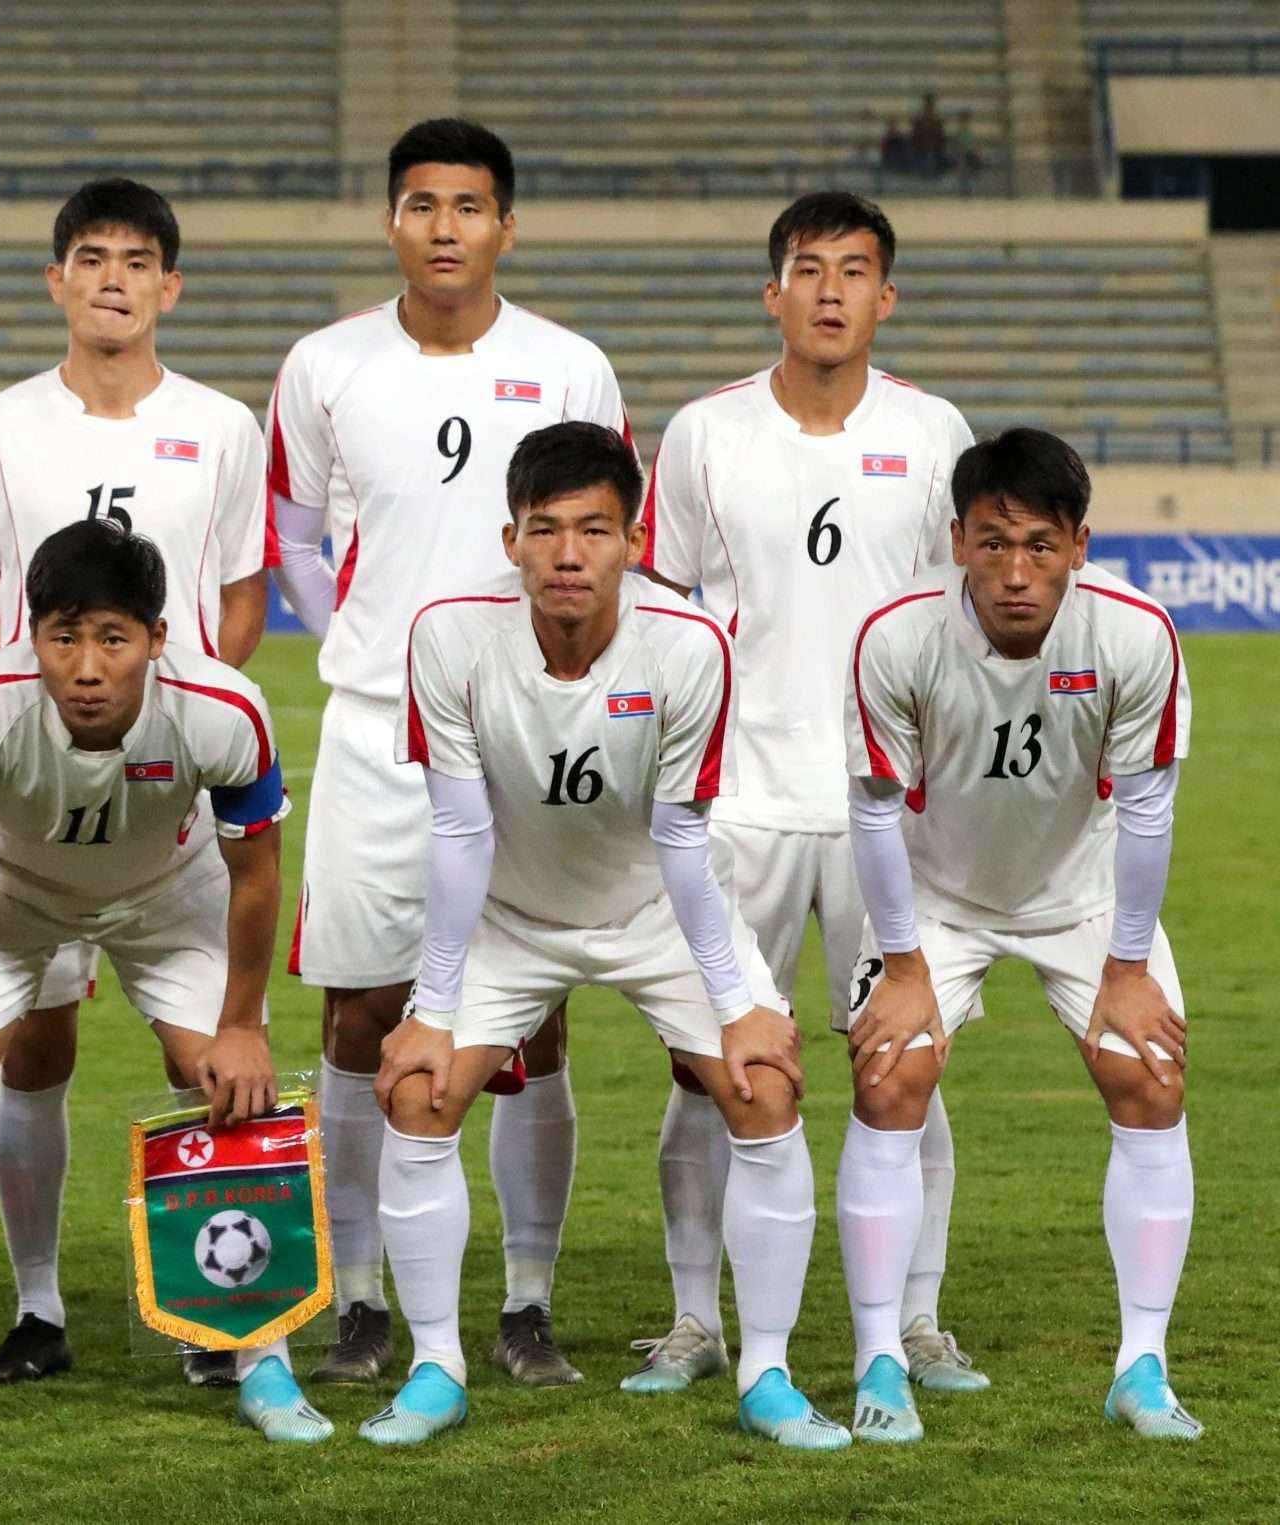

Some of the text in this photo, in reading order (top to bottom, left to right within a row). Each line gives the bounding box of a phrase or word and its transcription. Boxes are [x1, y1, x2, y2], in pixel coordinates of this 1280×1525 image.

[436, 415, 472, 485] 9
[85, 482, 136, 538] 15
[806, 496, 843, 567] 6
[539, 744, 605, 806] 16
[982, 712, 1043, 780] 13
[58, 797, 113, 846] 11
